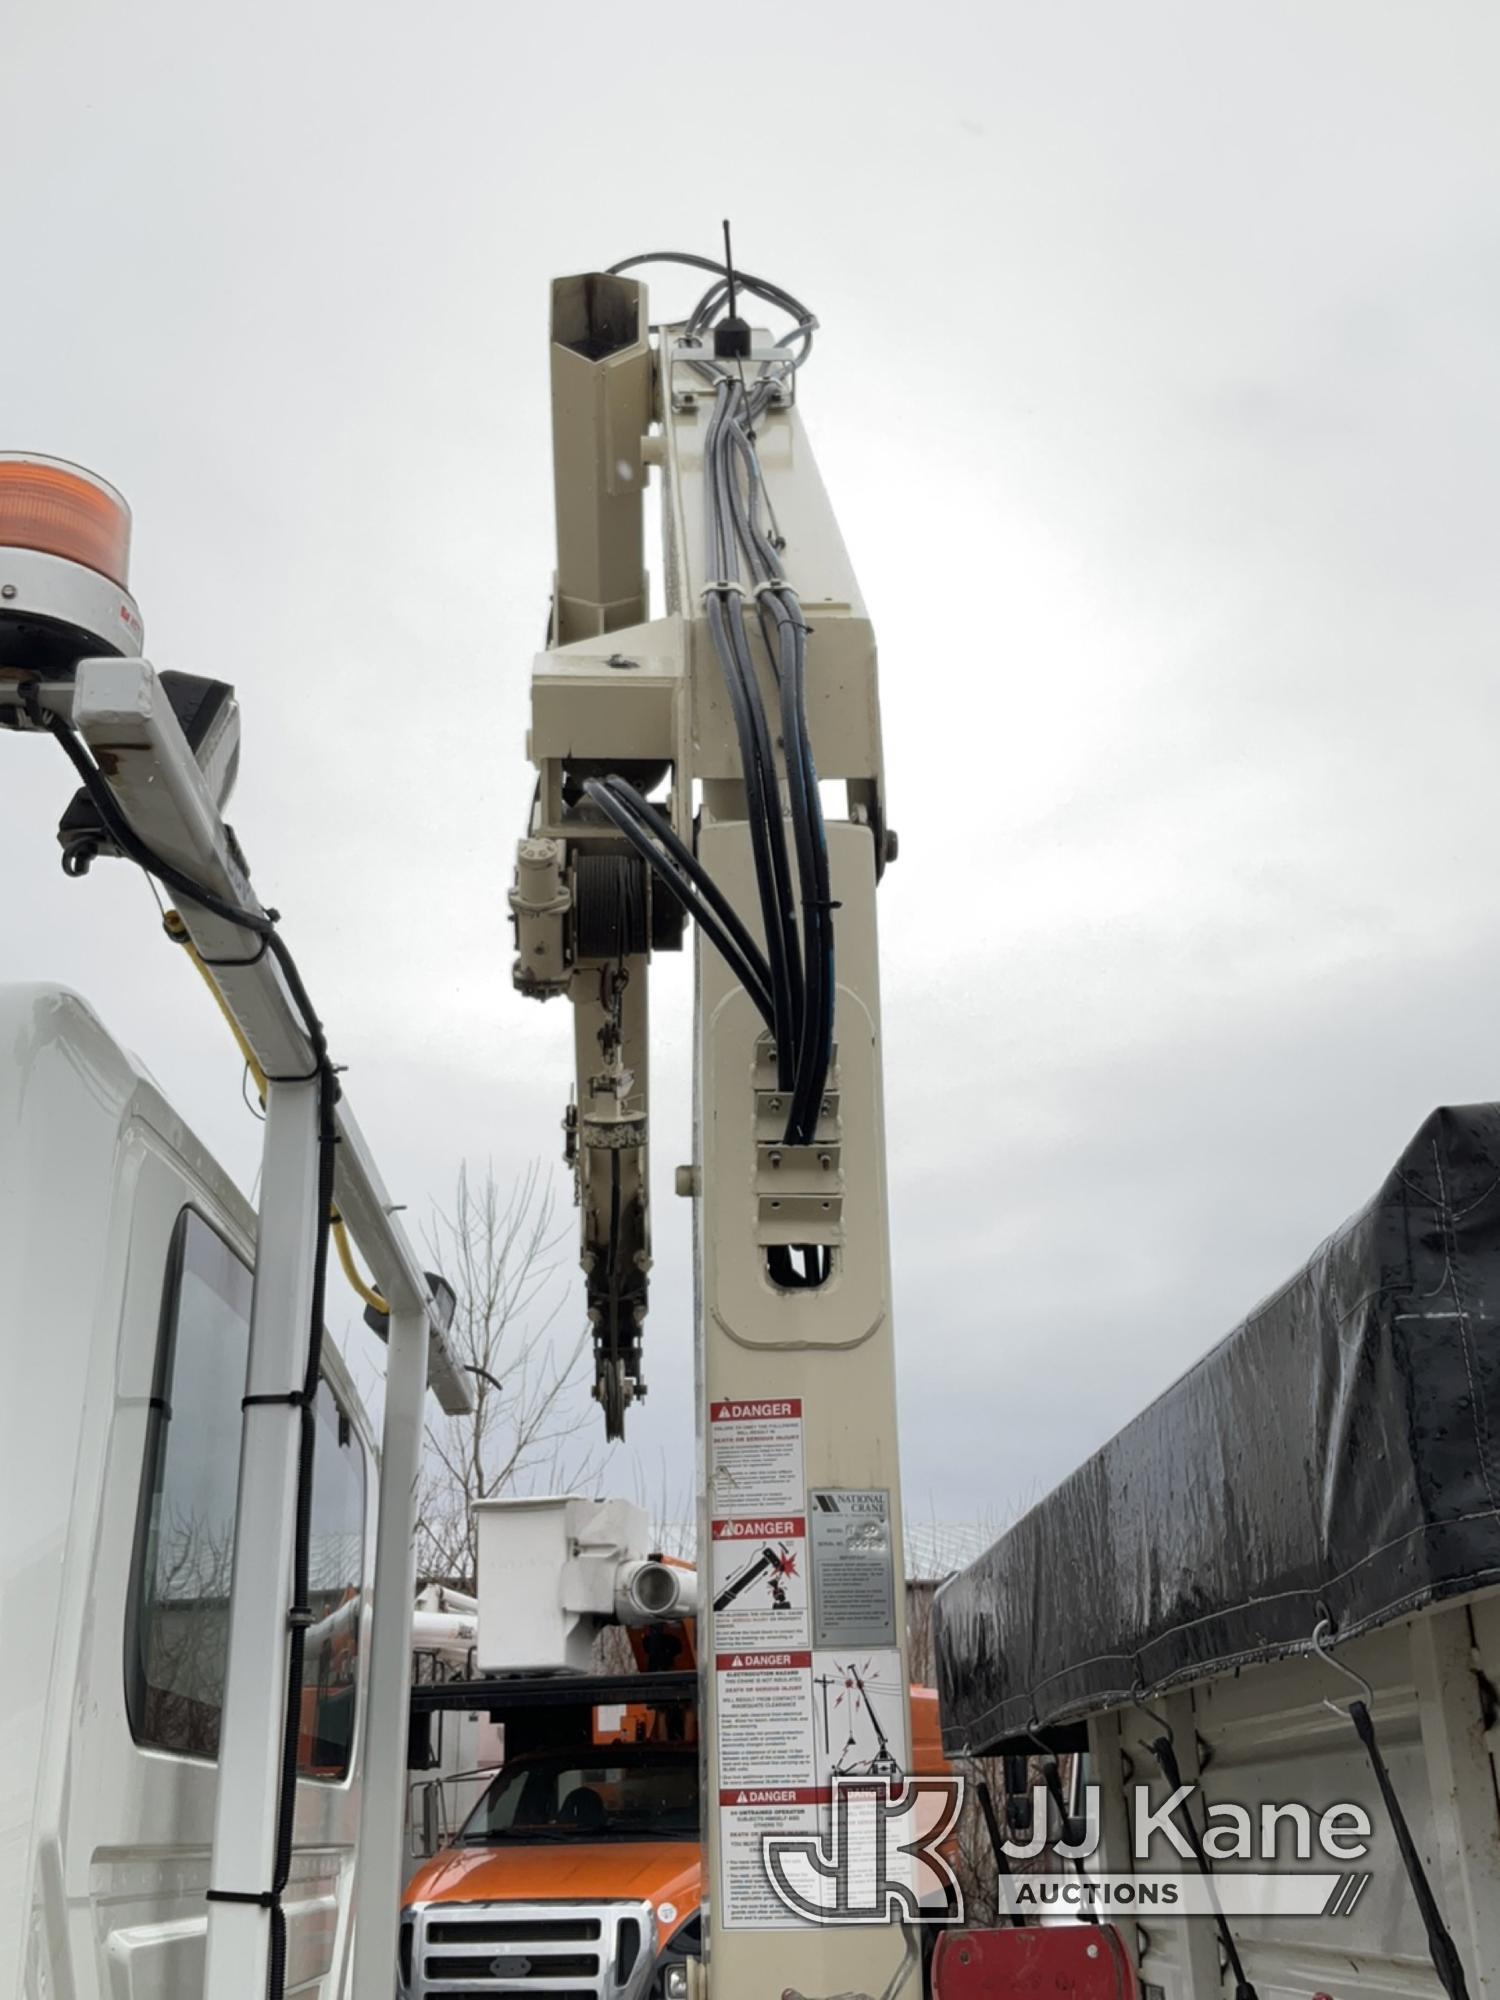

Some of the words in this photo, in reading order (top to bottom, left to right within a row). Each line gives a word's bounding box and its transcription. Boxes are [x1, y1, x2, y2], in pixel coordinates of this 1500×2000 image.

[732, 1403, 792, 1418] DANGER
[838, 1495, 884, 1504] NATIONAL
[851, 1503, 884, 1512] CRANE
[734, 1521, 794, 1536] DANGER
[745, 1655, 791, 1667] DANGER
[749, 1790, 797, 1802] DANGER
